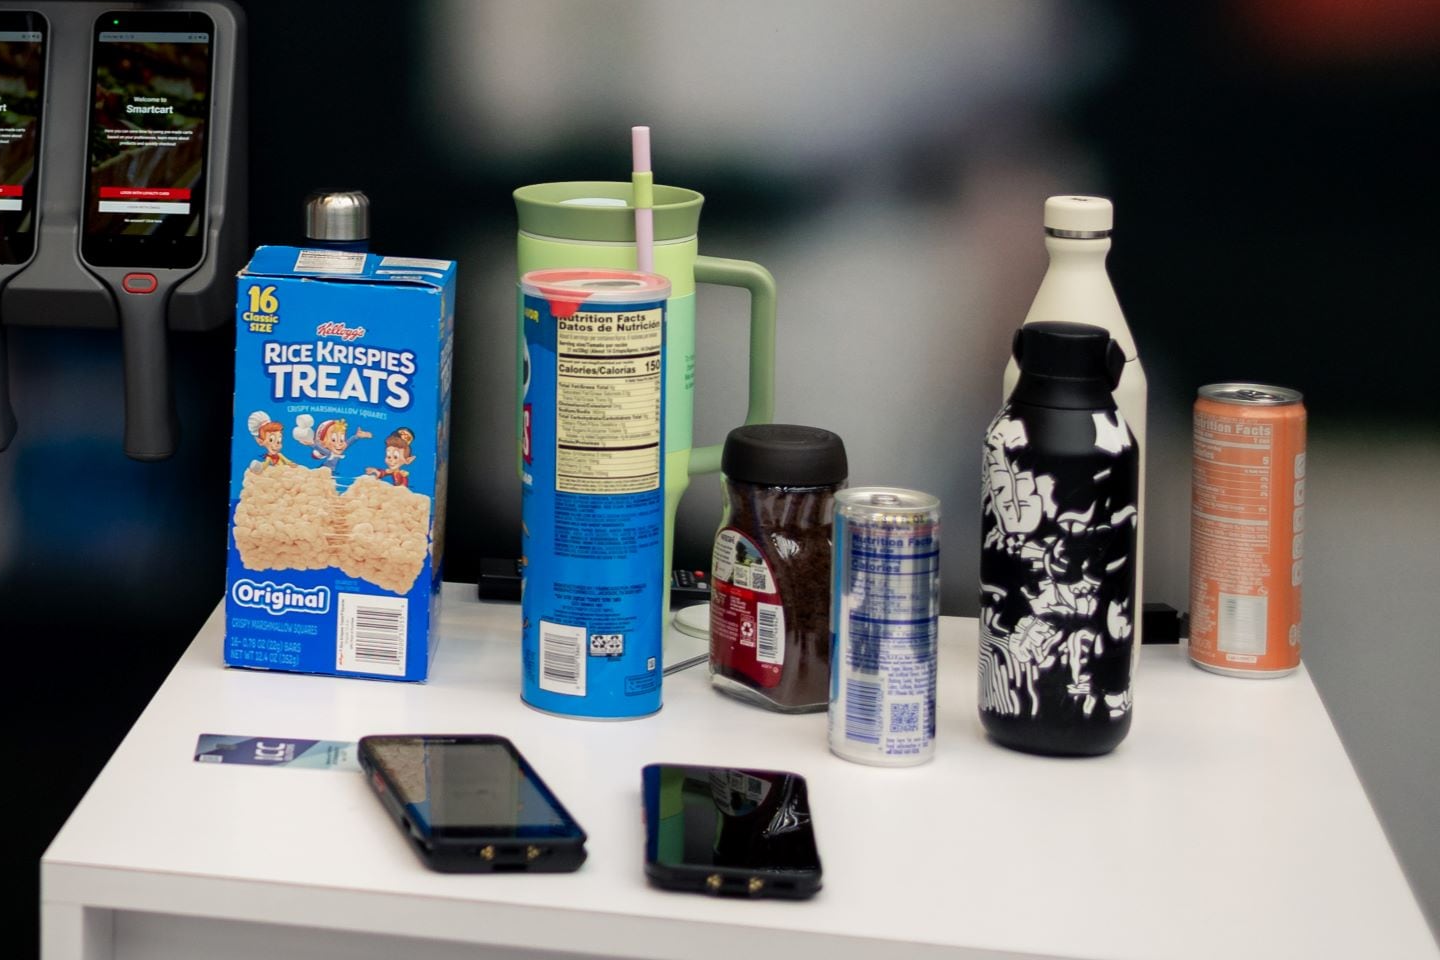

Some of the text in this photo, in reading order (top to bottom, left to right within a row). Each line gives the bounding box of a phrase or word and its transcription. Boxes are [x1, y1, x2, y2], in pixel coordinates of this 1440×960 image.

[126, 105, 174, 114] Smartcart
[248, 286, 279, 314] 16
[243, 313, 279, 324] Classic
[617, 314, 646, 323] Facts
[250, 323, 273, 333] SIZE
[317, 322, 366, 340] Kellogg's
[559, 323, 594, 332] Datos
[597, 323, 613, 332] de
[264, 341, 416, 375] RICE KRISPIES
[645, 360, 661, 372] 150
[268, 365, 411, 409] TREATS
[287, 405, 388, 420] CRISPY MARSHMALLOW SQUARES
[1236, 424, 1271, 436] Facts
[852, 534, 904, 548] Nutrition
[852, 560, 900, 572] Calories
[238, 585, 325, 610] Original
